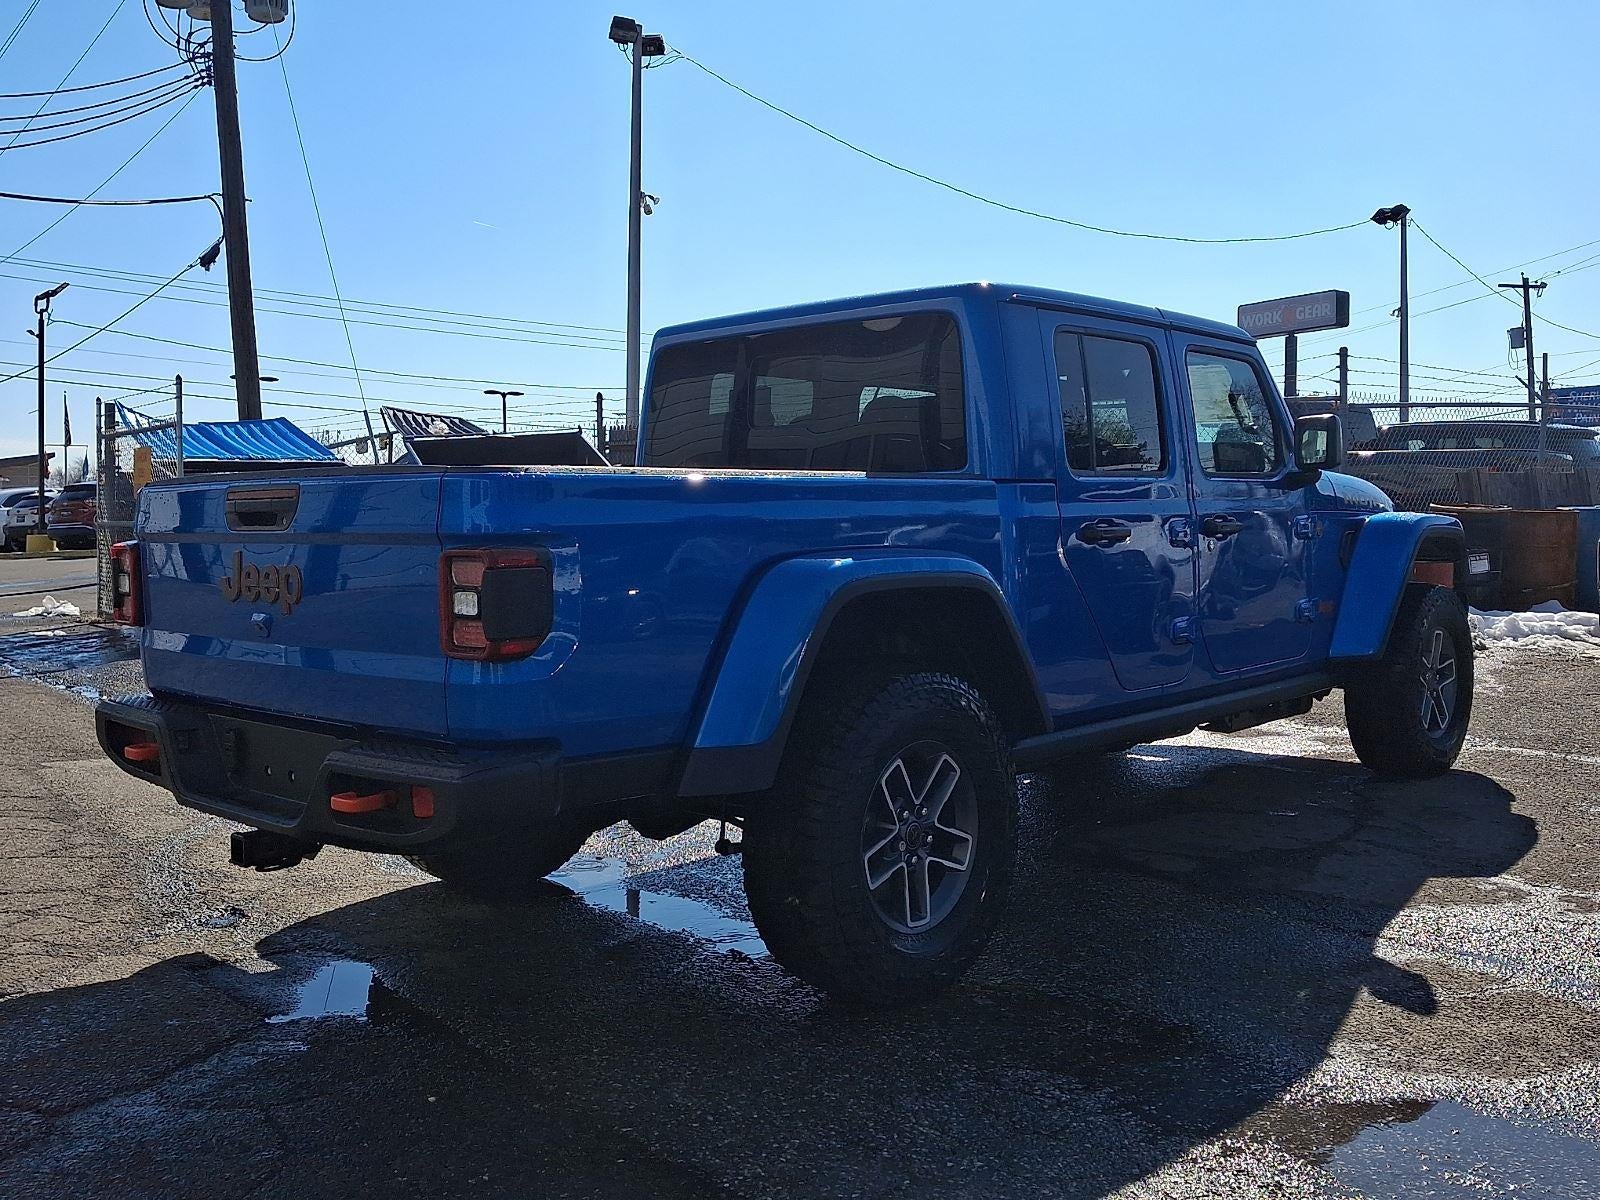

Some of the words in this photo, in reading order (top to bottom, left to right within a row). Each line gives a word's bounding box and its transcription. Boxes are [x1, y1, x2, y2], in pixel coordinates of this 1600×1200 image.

[1241, 308, 1283, 328] WORK
[1296, 303, 1332, 320] GEAR
[219, 550, 302, 616] Jeep
